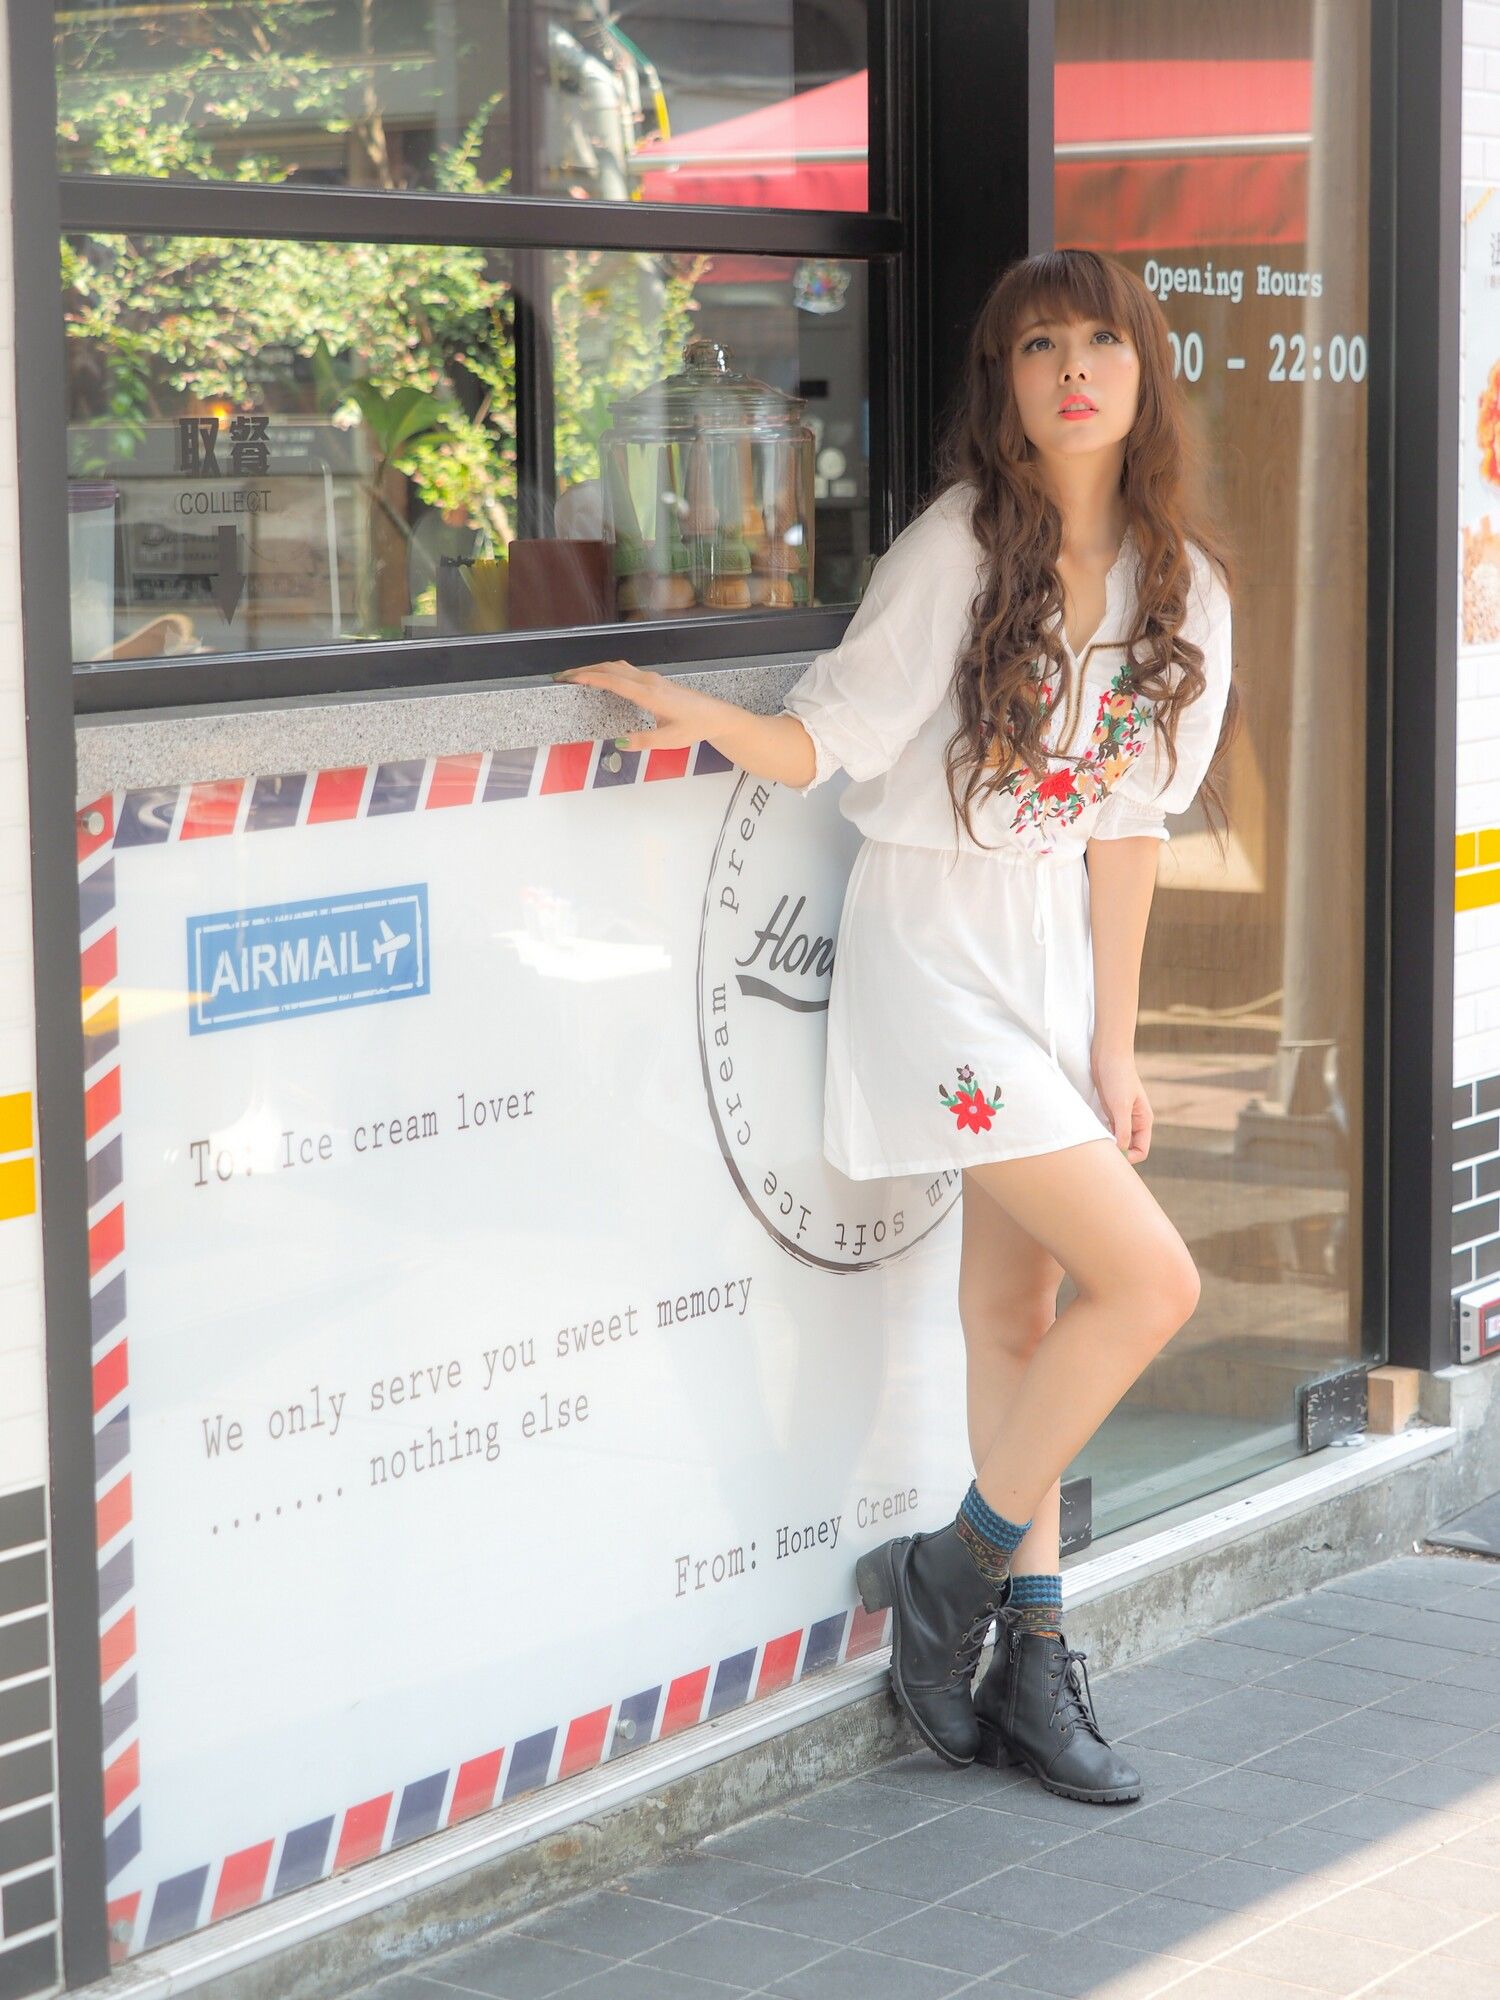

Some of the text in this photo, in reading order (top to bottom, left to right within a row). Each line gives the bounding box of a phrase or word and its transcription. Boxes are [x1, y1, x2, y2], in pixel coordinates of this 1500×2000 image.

[1144, 259, 1323, 304] Opening Hours
[1268, 333, 1368, 384] 22:00
[179, 416, 271, 478] 取餐
[180, 490, 272, 515] COLLECT
[720, 781, 777, 914] prem
[208, 930, 373, 999] AIRMAIL
[735, 895, 836, 977] Hon
[282, 1131, 333, 1168] Ice
[354, 1111, 439, 1152] cream
[457, 1088, 536, 1132] lover
[712, 983, 905, 1256] soft ice cream
[203, 1276, 753, 1458] We only serve you sweet memory
[369, 1420, 501, 1486] nothing
[521, 1394, 590, 1438] else
[675, 1487, 919, 1598] From: Honey Creme
